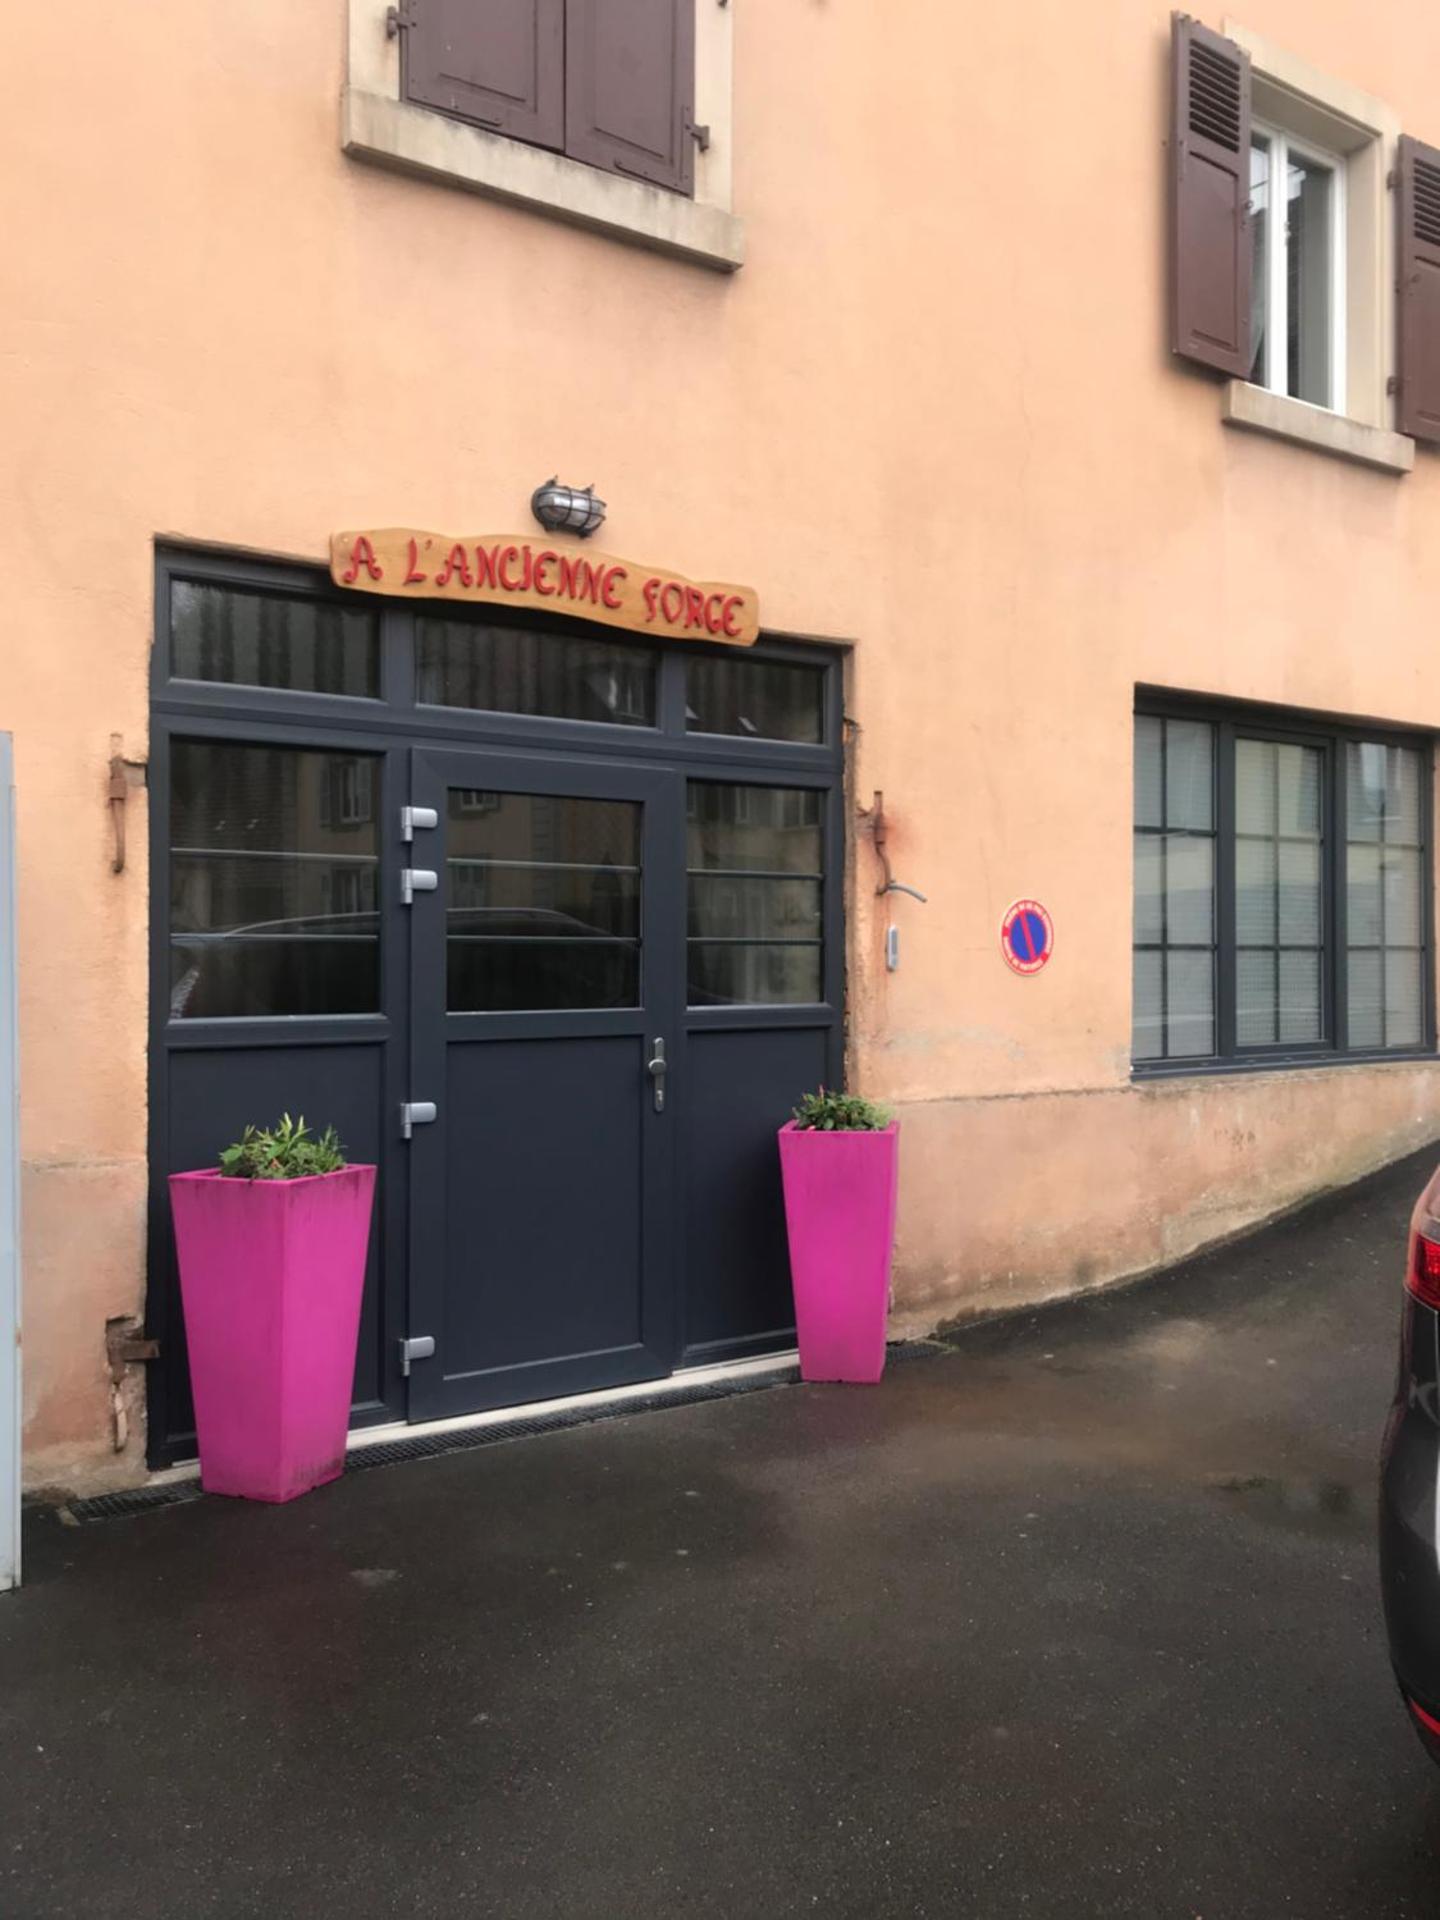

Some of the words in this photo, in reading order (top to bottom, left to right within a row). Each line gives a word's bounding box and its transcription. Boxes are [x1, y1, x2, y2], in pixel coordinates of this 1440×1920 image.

[343, 537, 382, 583] A
[404, 538, 627, 608] L'ANCIENNE
[643, 577, 742, 637] FORGE
